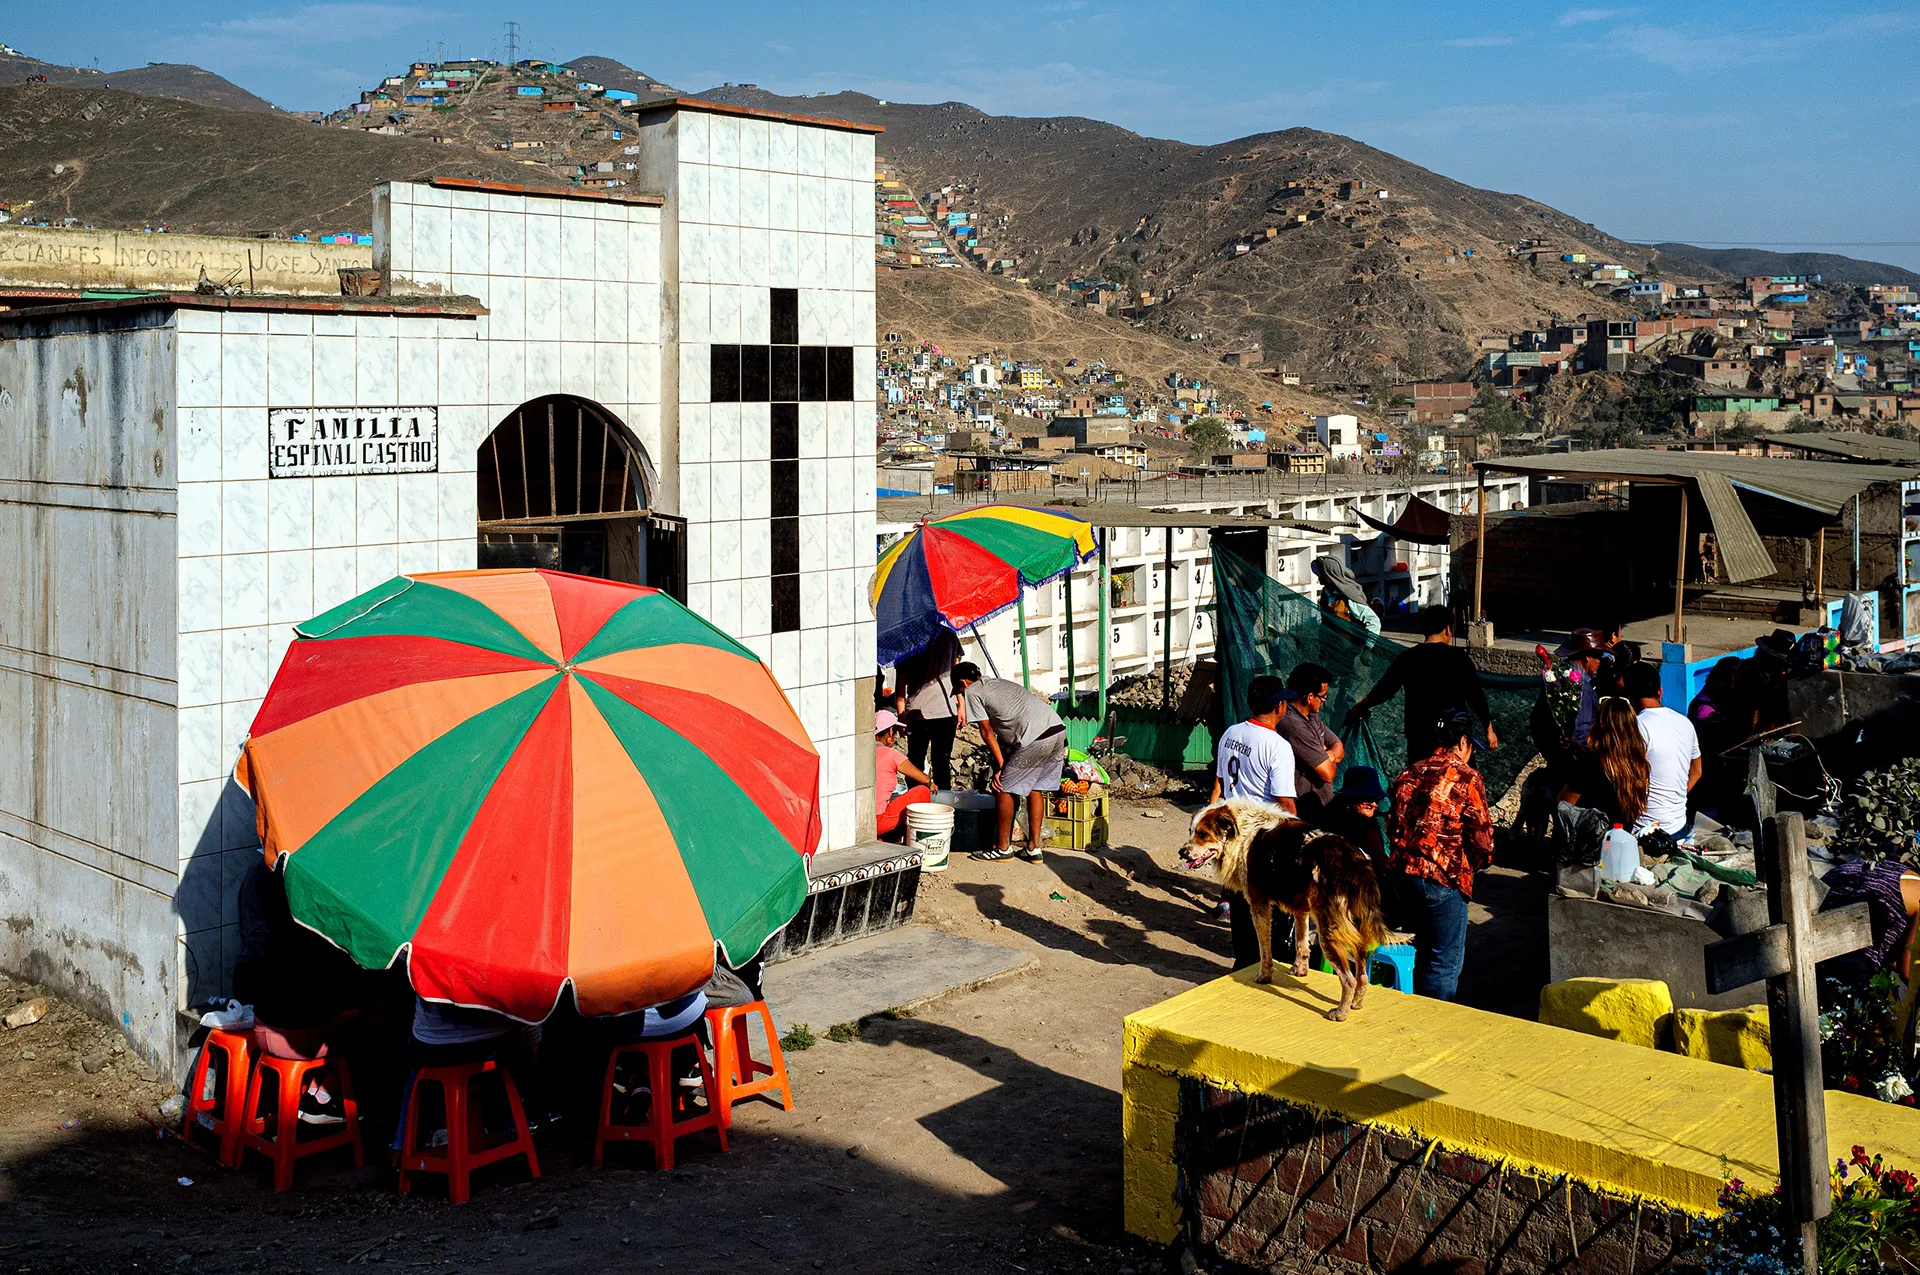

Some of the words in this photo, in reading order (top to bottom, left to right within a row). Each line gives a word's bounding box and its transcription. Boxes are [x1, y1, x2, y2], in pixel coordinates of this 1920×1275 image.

[284, 417, 420, 441] FAMILIA
[275, 443, 357, 467] ESPINAL
[362, 441, 431, 464] CASTRO
[1195, 569, 1201, 584] 4
[1278, 558, 1285, 572] 2
[1113, 628, 1120, 643] 5
[1154, 621, 1160, 636] 4
[1196, 615, 1203, 629] 3
[1228, 755, 1240, 792] 9
